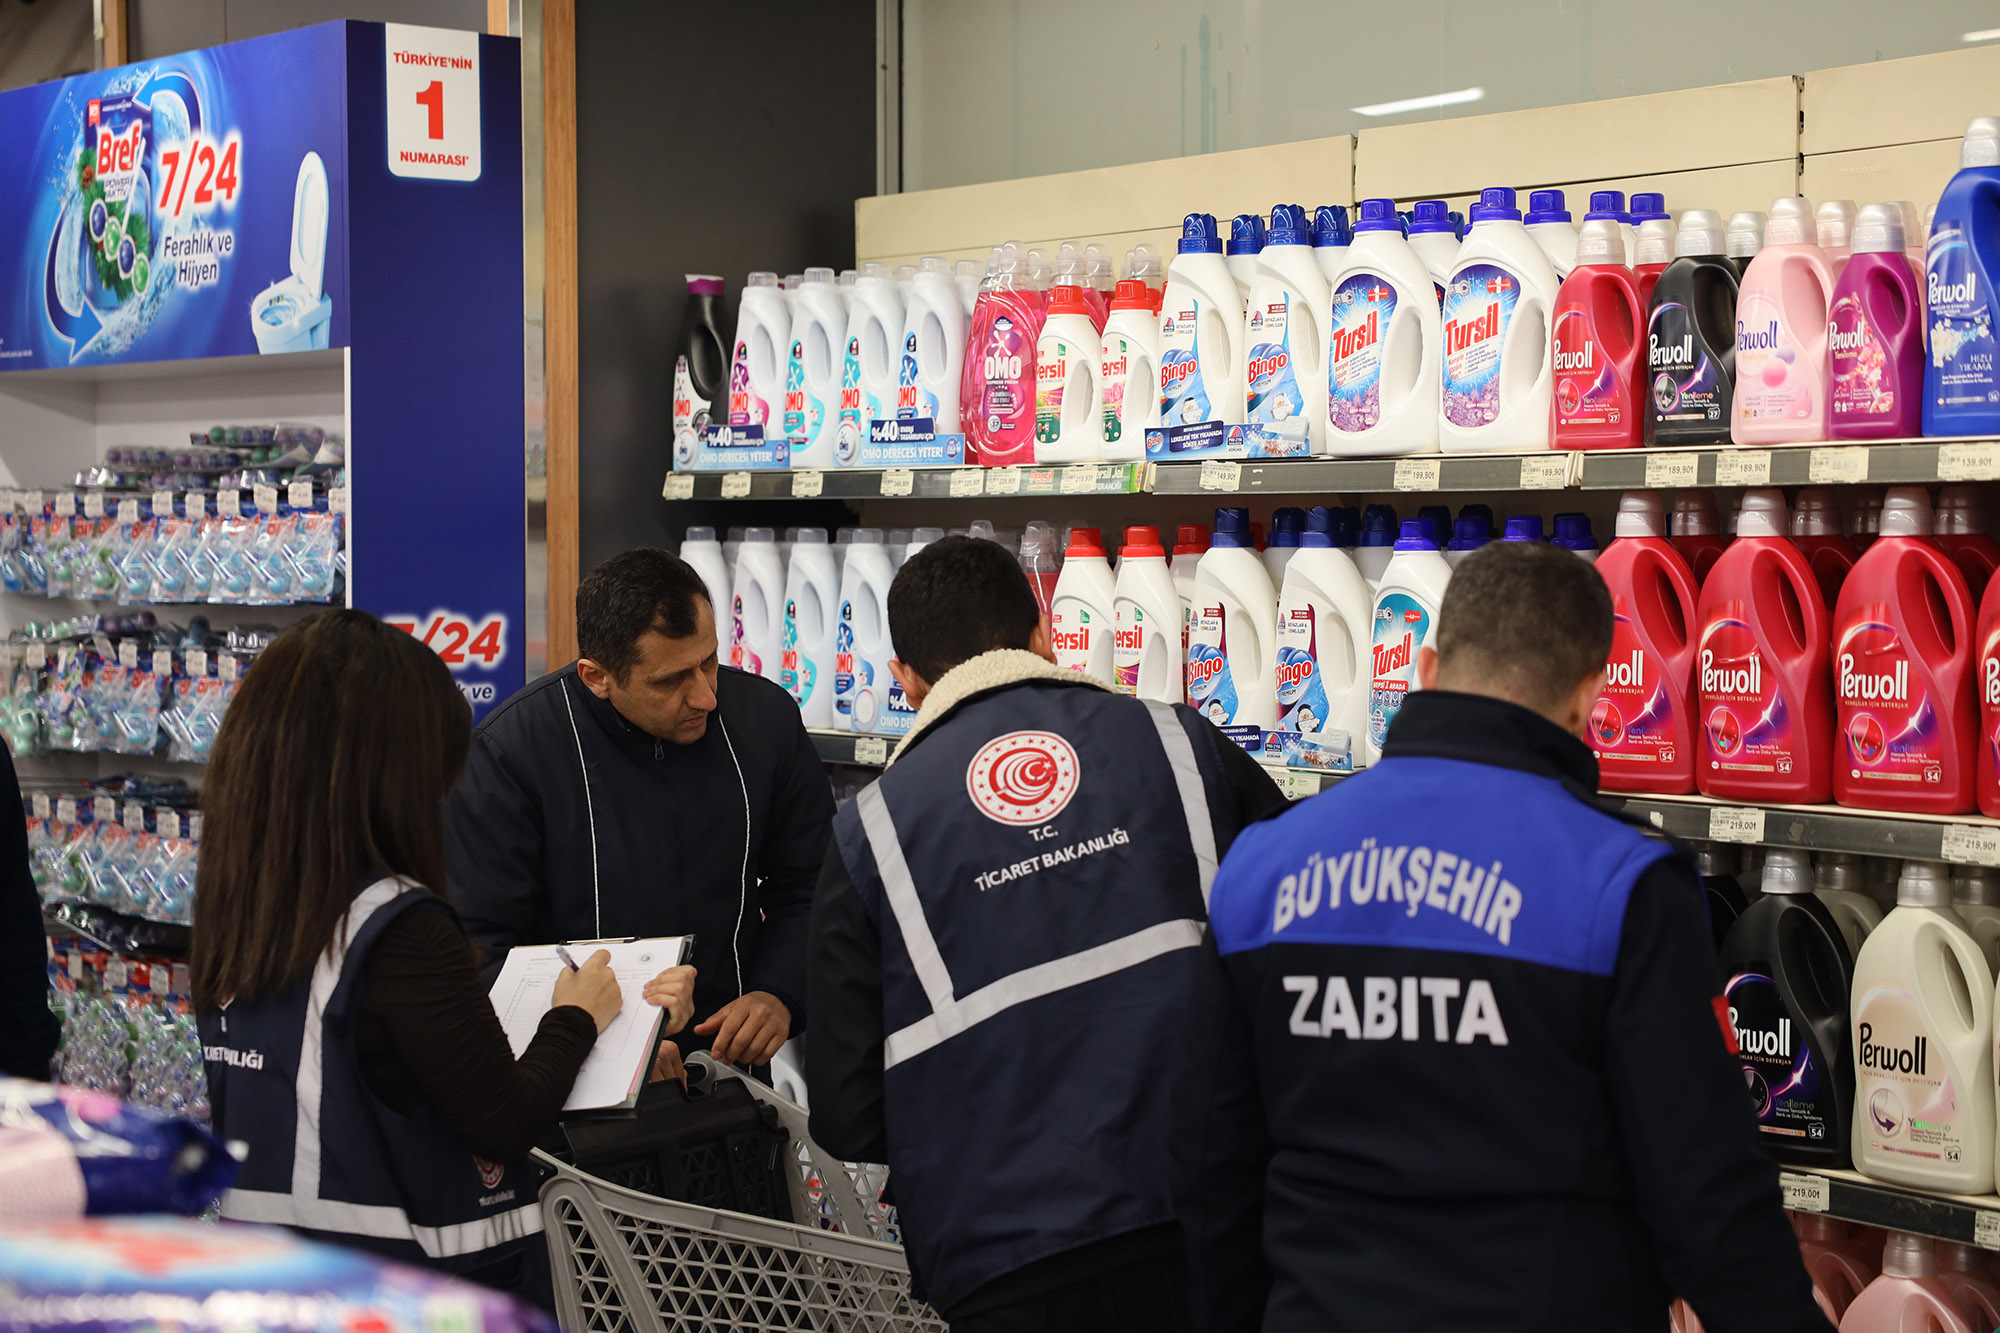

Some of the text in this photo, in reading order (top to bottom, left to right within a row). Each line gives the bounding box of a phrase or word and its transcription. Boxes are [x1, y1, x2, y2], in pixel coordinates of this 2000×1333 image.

[393, 51, 472, 70] TÜRKİYE'NİN
[416, 80, 444, 140] 1
[97, 124, 140, 174] Bref
[159, 140, 238, 217] 7/24
[164, 232, 232, 257] Ferahlık ve
[178, 260, 217, 286] Hijyen
[1928, 272, 1976, 305] Perwoll
[1333, 310, 1377, 363] Tursil
[1445, 302, 1499, 356] Tursil
[1737, 320, 1778, 352] Perwoll
[1829, 320, 1865, 352] Perwoll
[1553, 339, 1593, 370] Perwoll
[1649, 333, 1693, 366] Perwoll
[984, 356, 1022, 380] OMO
[1161, 360, 1197, 388] Bingo
[1248, 353, 1288, 384] Bingo
[675, 399, 691, 417] OMO
[785, 391, 804, 412] OMO
[841, 388, 860, 410] OMO
[897, 385, 917, 408] OMO
[862, 446, 944, 460] OMO DERECESİ YETER!
[835, 654, 853, 674] OMO
[1372, 632, 1412, 678] Tursil
[1188, 657, 1223, 687] Bingo
[1275, 661, 1313, 690] Bingo
[1701, 649, 1761, 694] Perwoll
[1840, 653, 1909, 700] Perwoll
[472, 686, 493, 699] ve
[880, 716, 899, 728] OMO
[1662, 753, 1673, 761] 54
[1779, 763, 1790, 771] 54
[1927, 772, 1938, 780] 54
[1028, 825, 1059, 842] T.C.
[974, 827, 1130, 892] TİCARET BAKANLIĞI
[1273, 837, 1523, 946] BÜYÜKŞEHİR
[1282, 975, 1509, 1046] ZABITA
[1859, 1022, 1927, 1075] Perwoll
[1811, 1128, 1822, 1137] 54
[1947, 1152, 1959, 1160] 54
